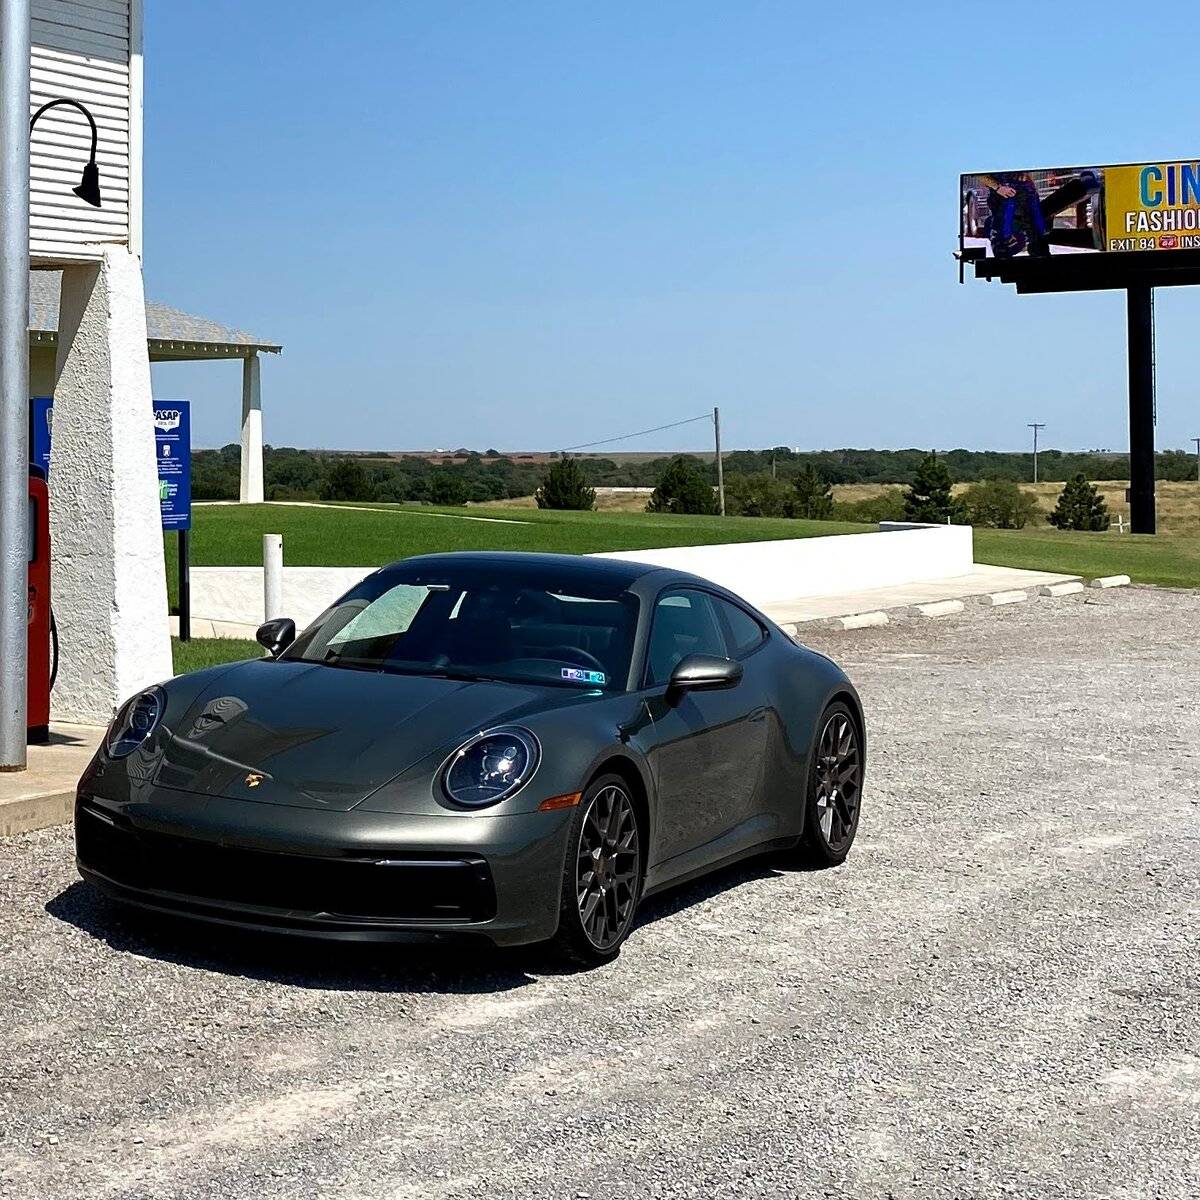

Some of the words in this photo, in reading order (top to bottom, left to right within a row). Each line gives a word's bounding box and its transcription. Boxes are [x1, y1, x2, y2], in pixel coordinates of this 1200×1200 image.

[1110, 238, 1136, 251] EXIT
[1139, 237, 1155, 249] 84
[155, 411, 178, 421] ASAP
